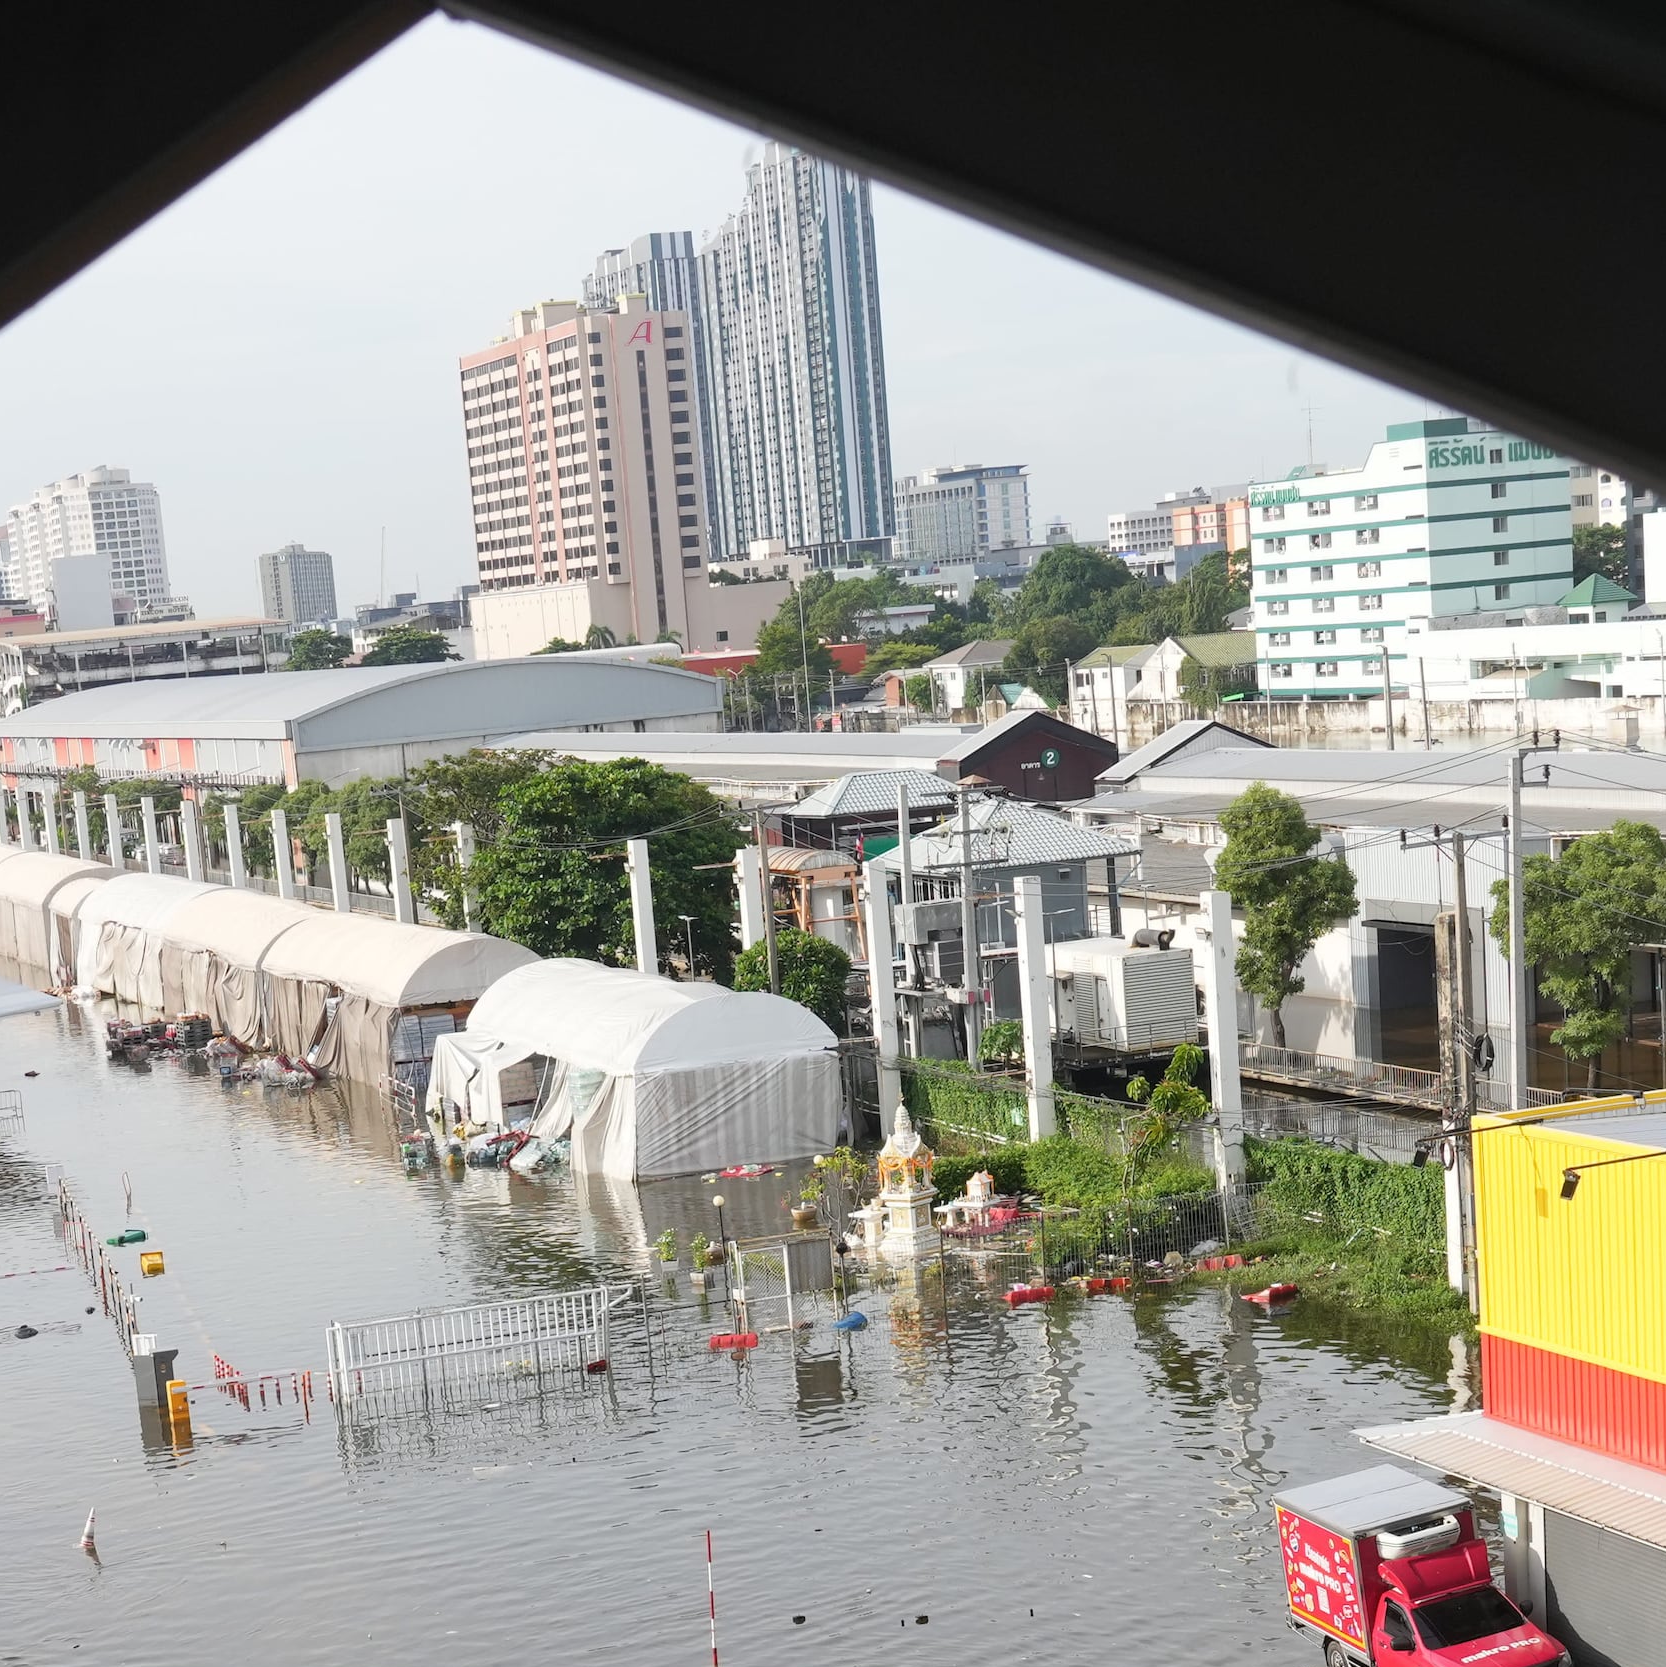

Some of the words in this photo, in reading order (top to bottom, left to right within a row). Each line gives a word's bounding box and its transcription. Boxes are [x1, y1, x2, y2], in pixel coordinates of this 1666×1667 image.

[624, 319, 652, 346] A
[1046, 751, 1055, 765] 2
[1325, 1573, 1342, 1594] PRO
[1461, 1645, 1510, 1664] makro
[1510, 1637, 1540, 1649] PRO
